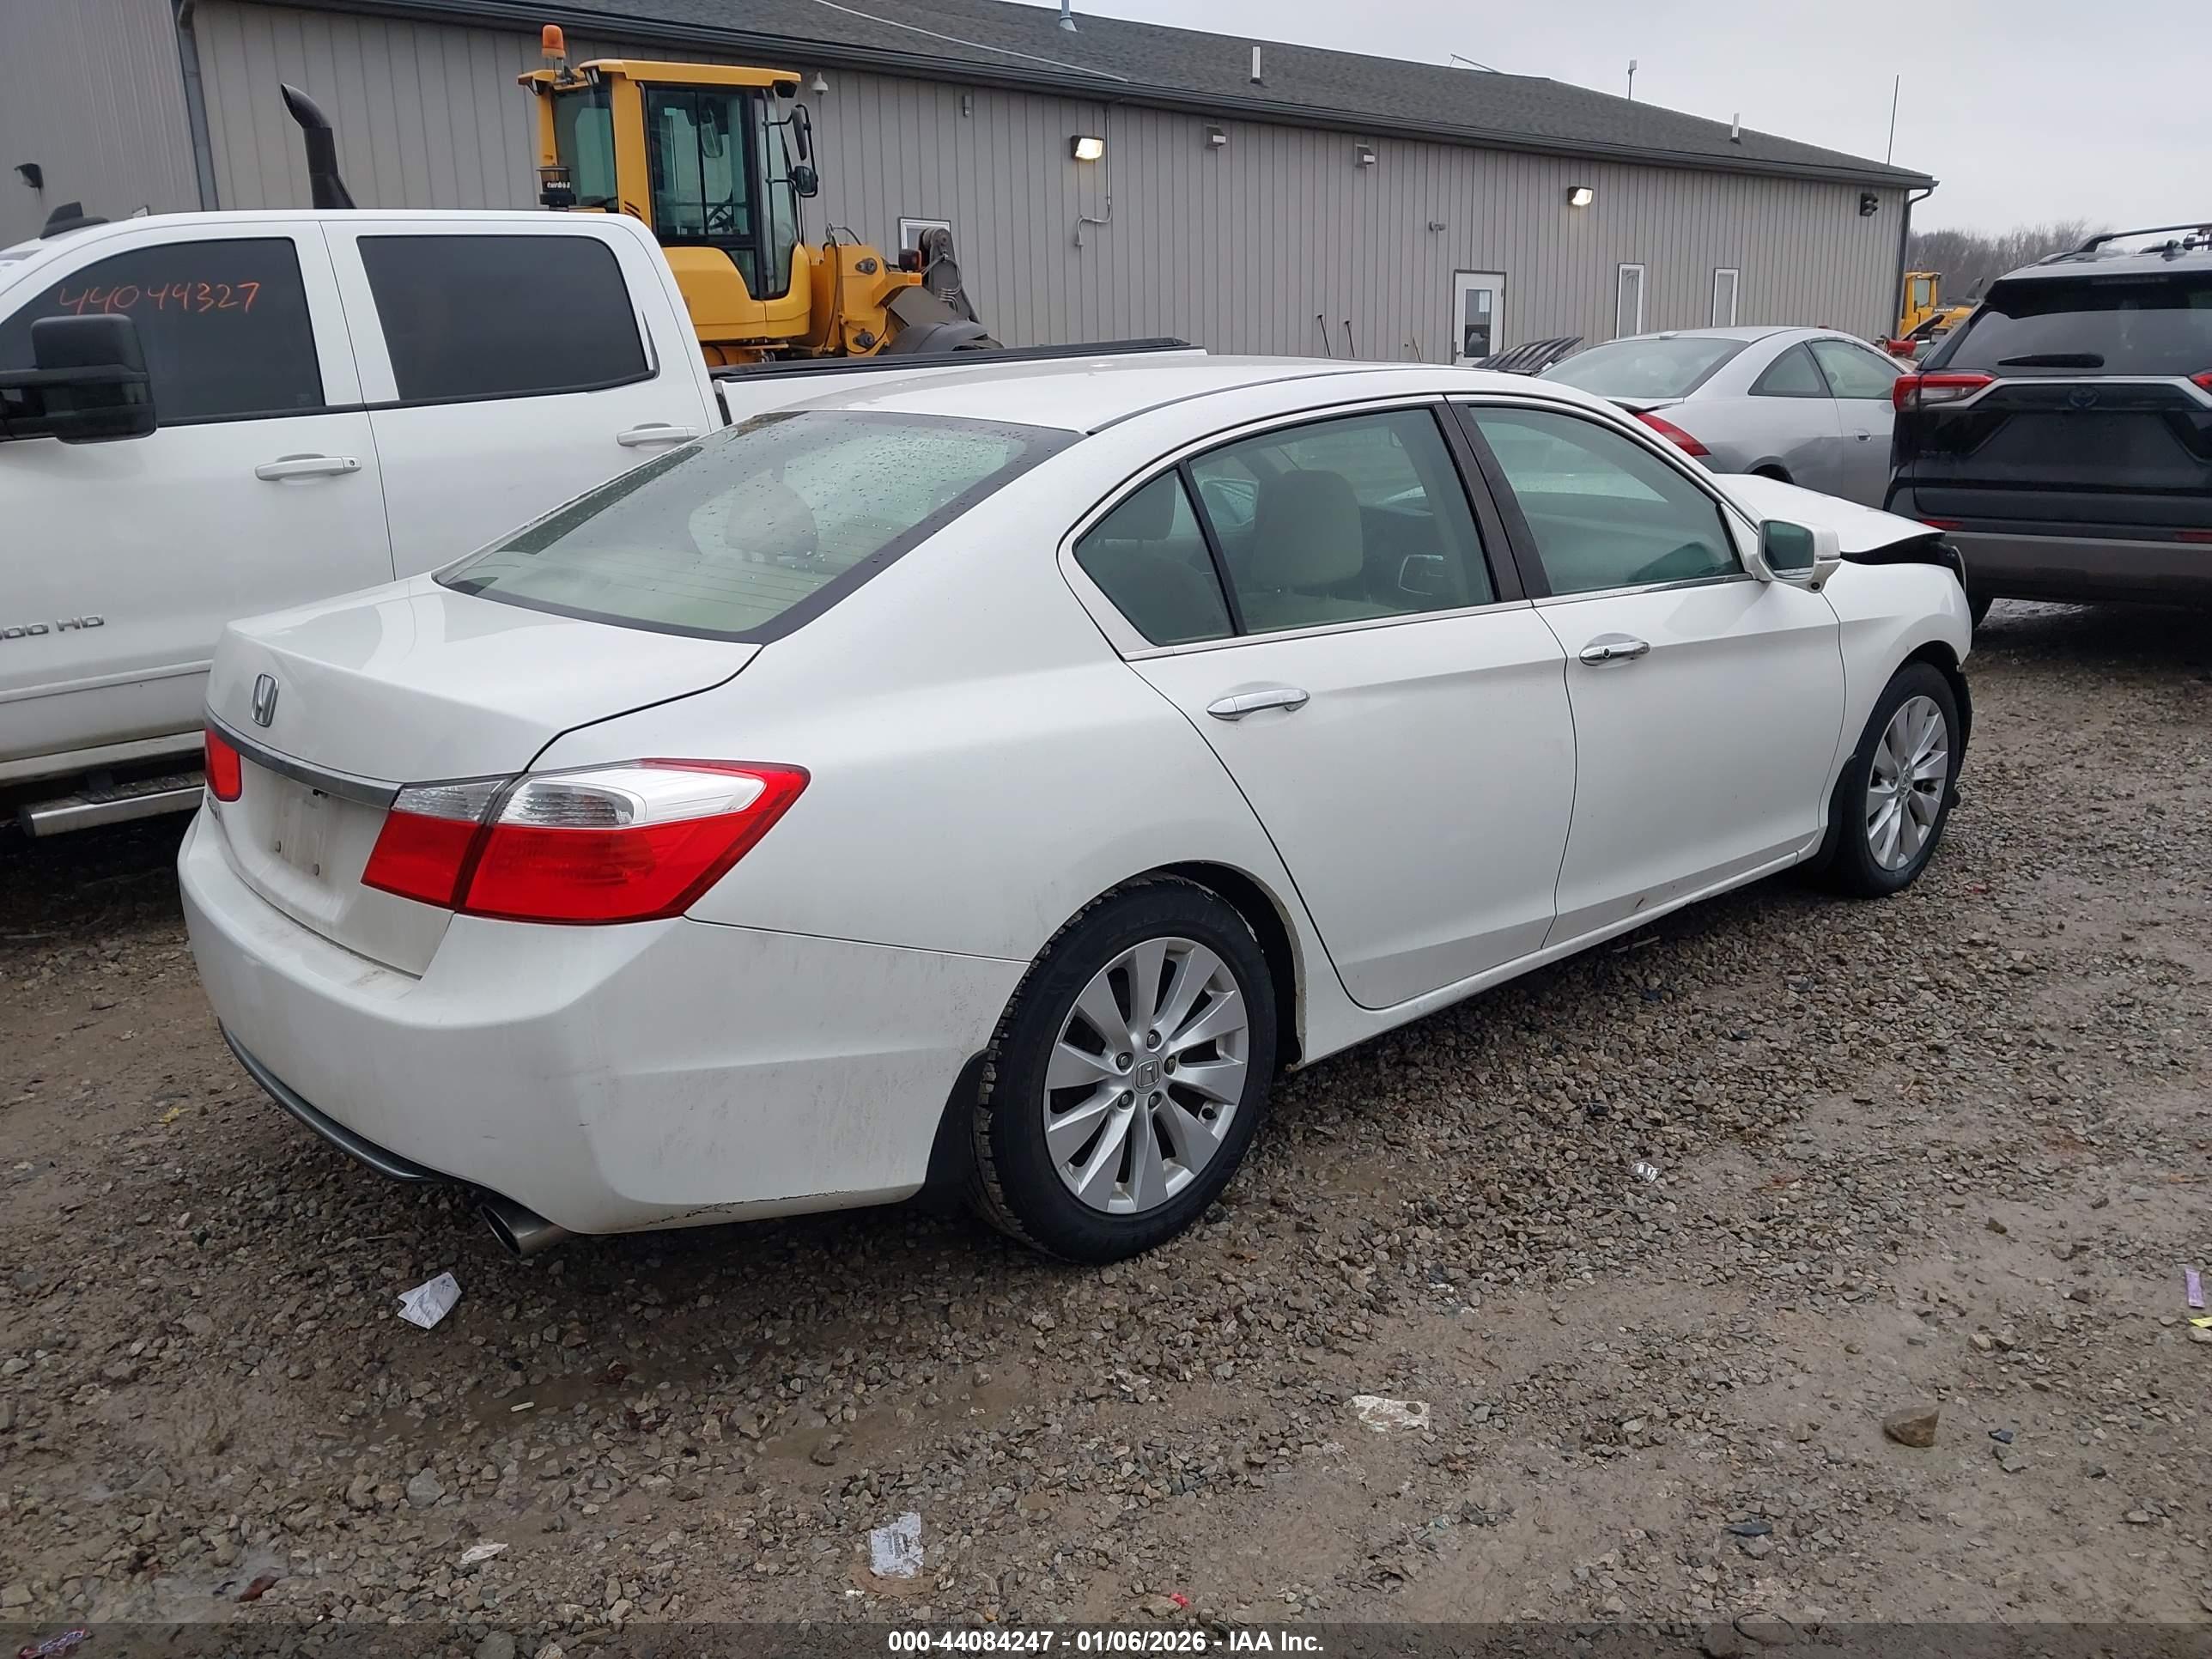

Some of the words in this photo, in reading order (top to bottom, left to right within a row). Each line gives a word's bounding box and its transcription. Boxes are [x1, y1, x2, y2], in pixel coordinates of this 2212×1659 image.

[59, 283, 260, 314] 44044327
[0, 623, 49, 641] 00
[56, 614, 104, 631] HD
